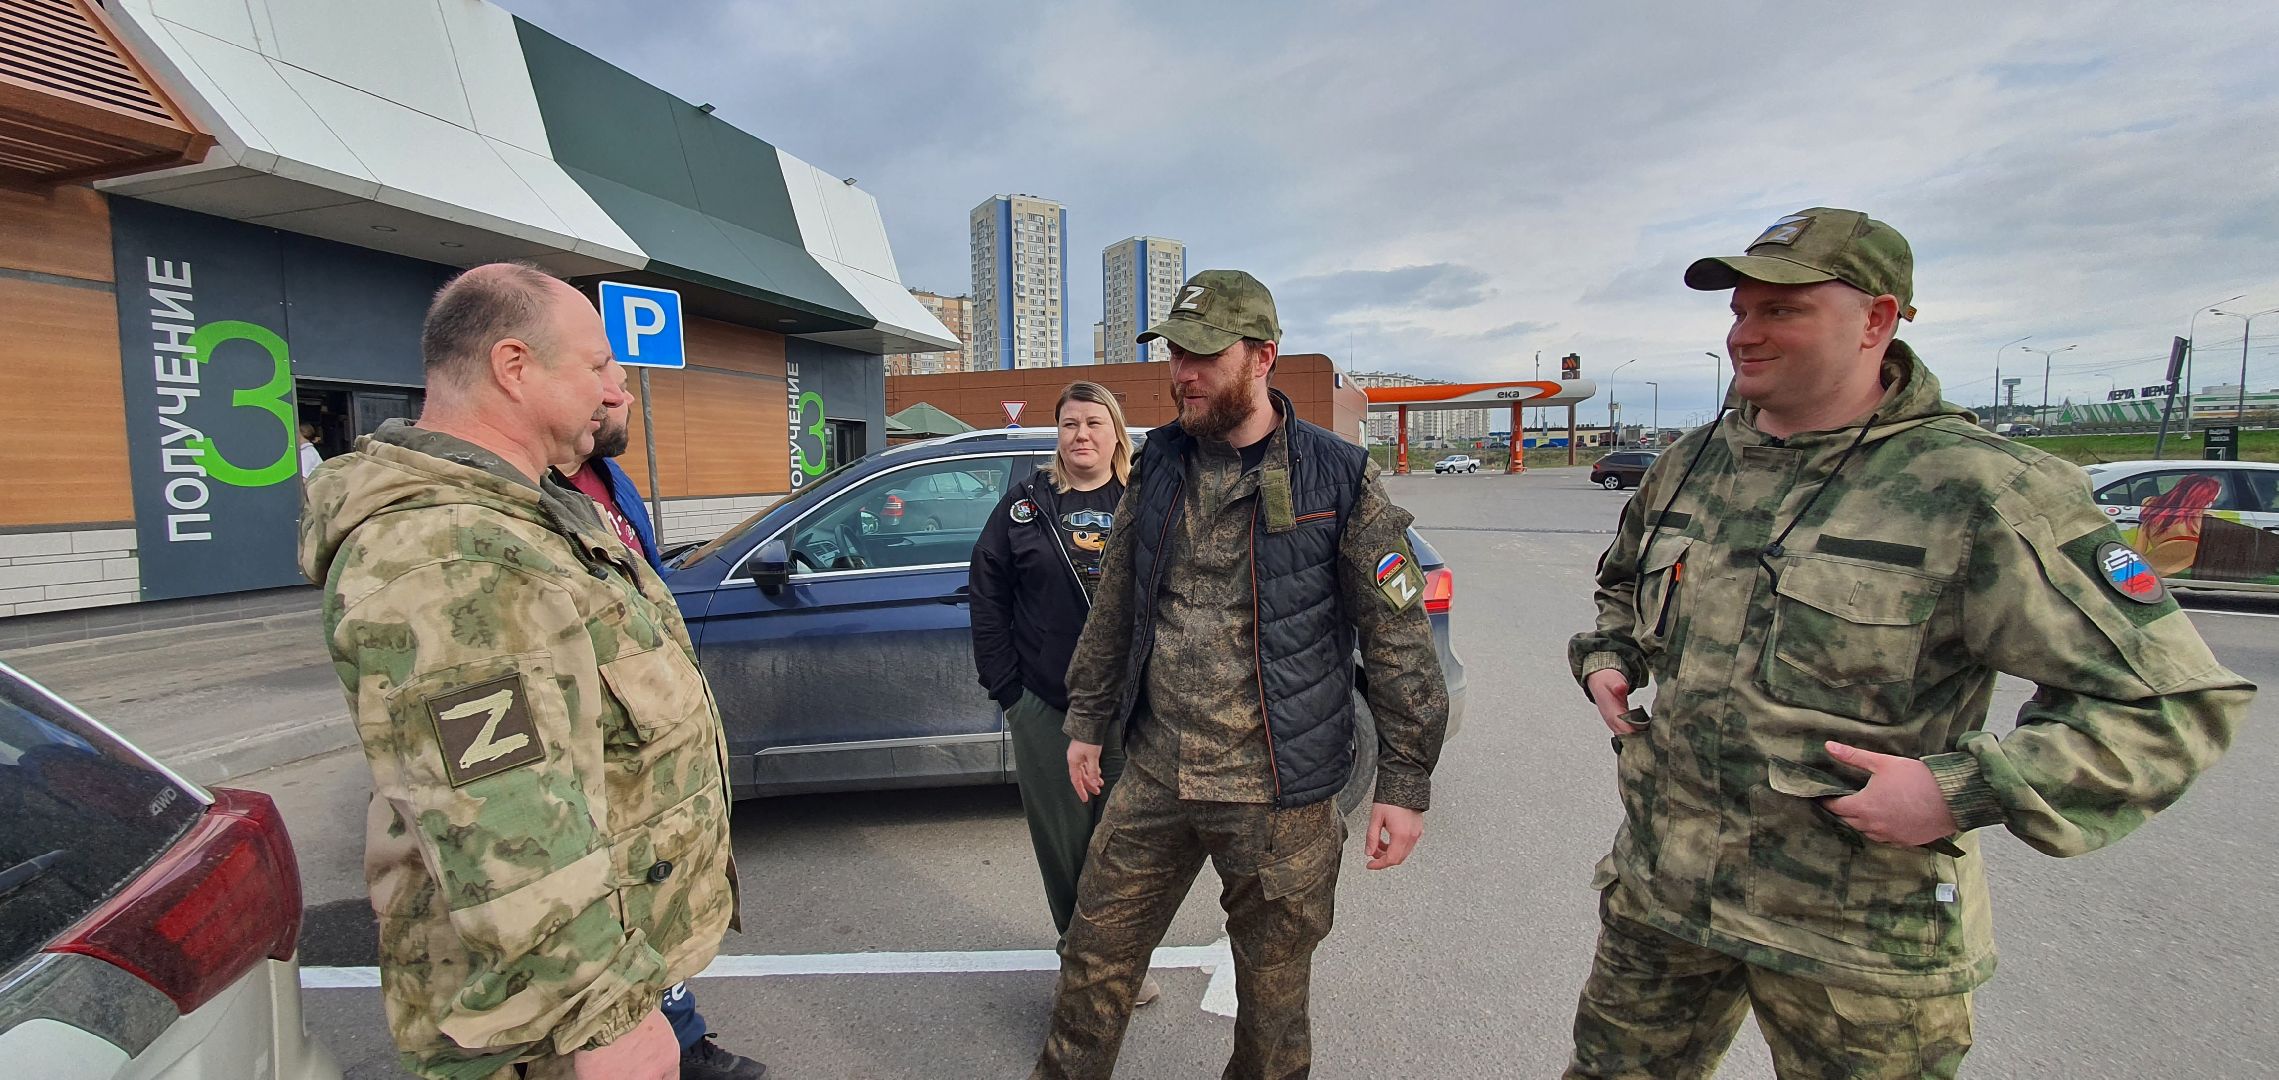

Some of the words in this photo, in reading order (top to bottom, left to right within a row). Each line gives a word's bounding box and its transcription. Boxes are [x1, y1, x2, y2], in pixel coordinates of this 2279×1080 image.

[623, 295, 666, 356] P
[1180, 286, 1205, 309] Z
[147, 256, 212, 541] ПОЛУЧЕНИЕ
[181, 320, 297, 487] 3
[787, 362, 803, 493] ОЛУЧЕНИЕ
[797, 391, 825, 475] 3
[1391, 573, 1417, 601] Z
[439, 689, 530, 769] Z
[149, 786, 177, 816] 4WD
